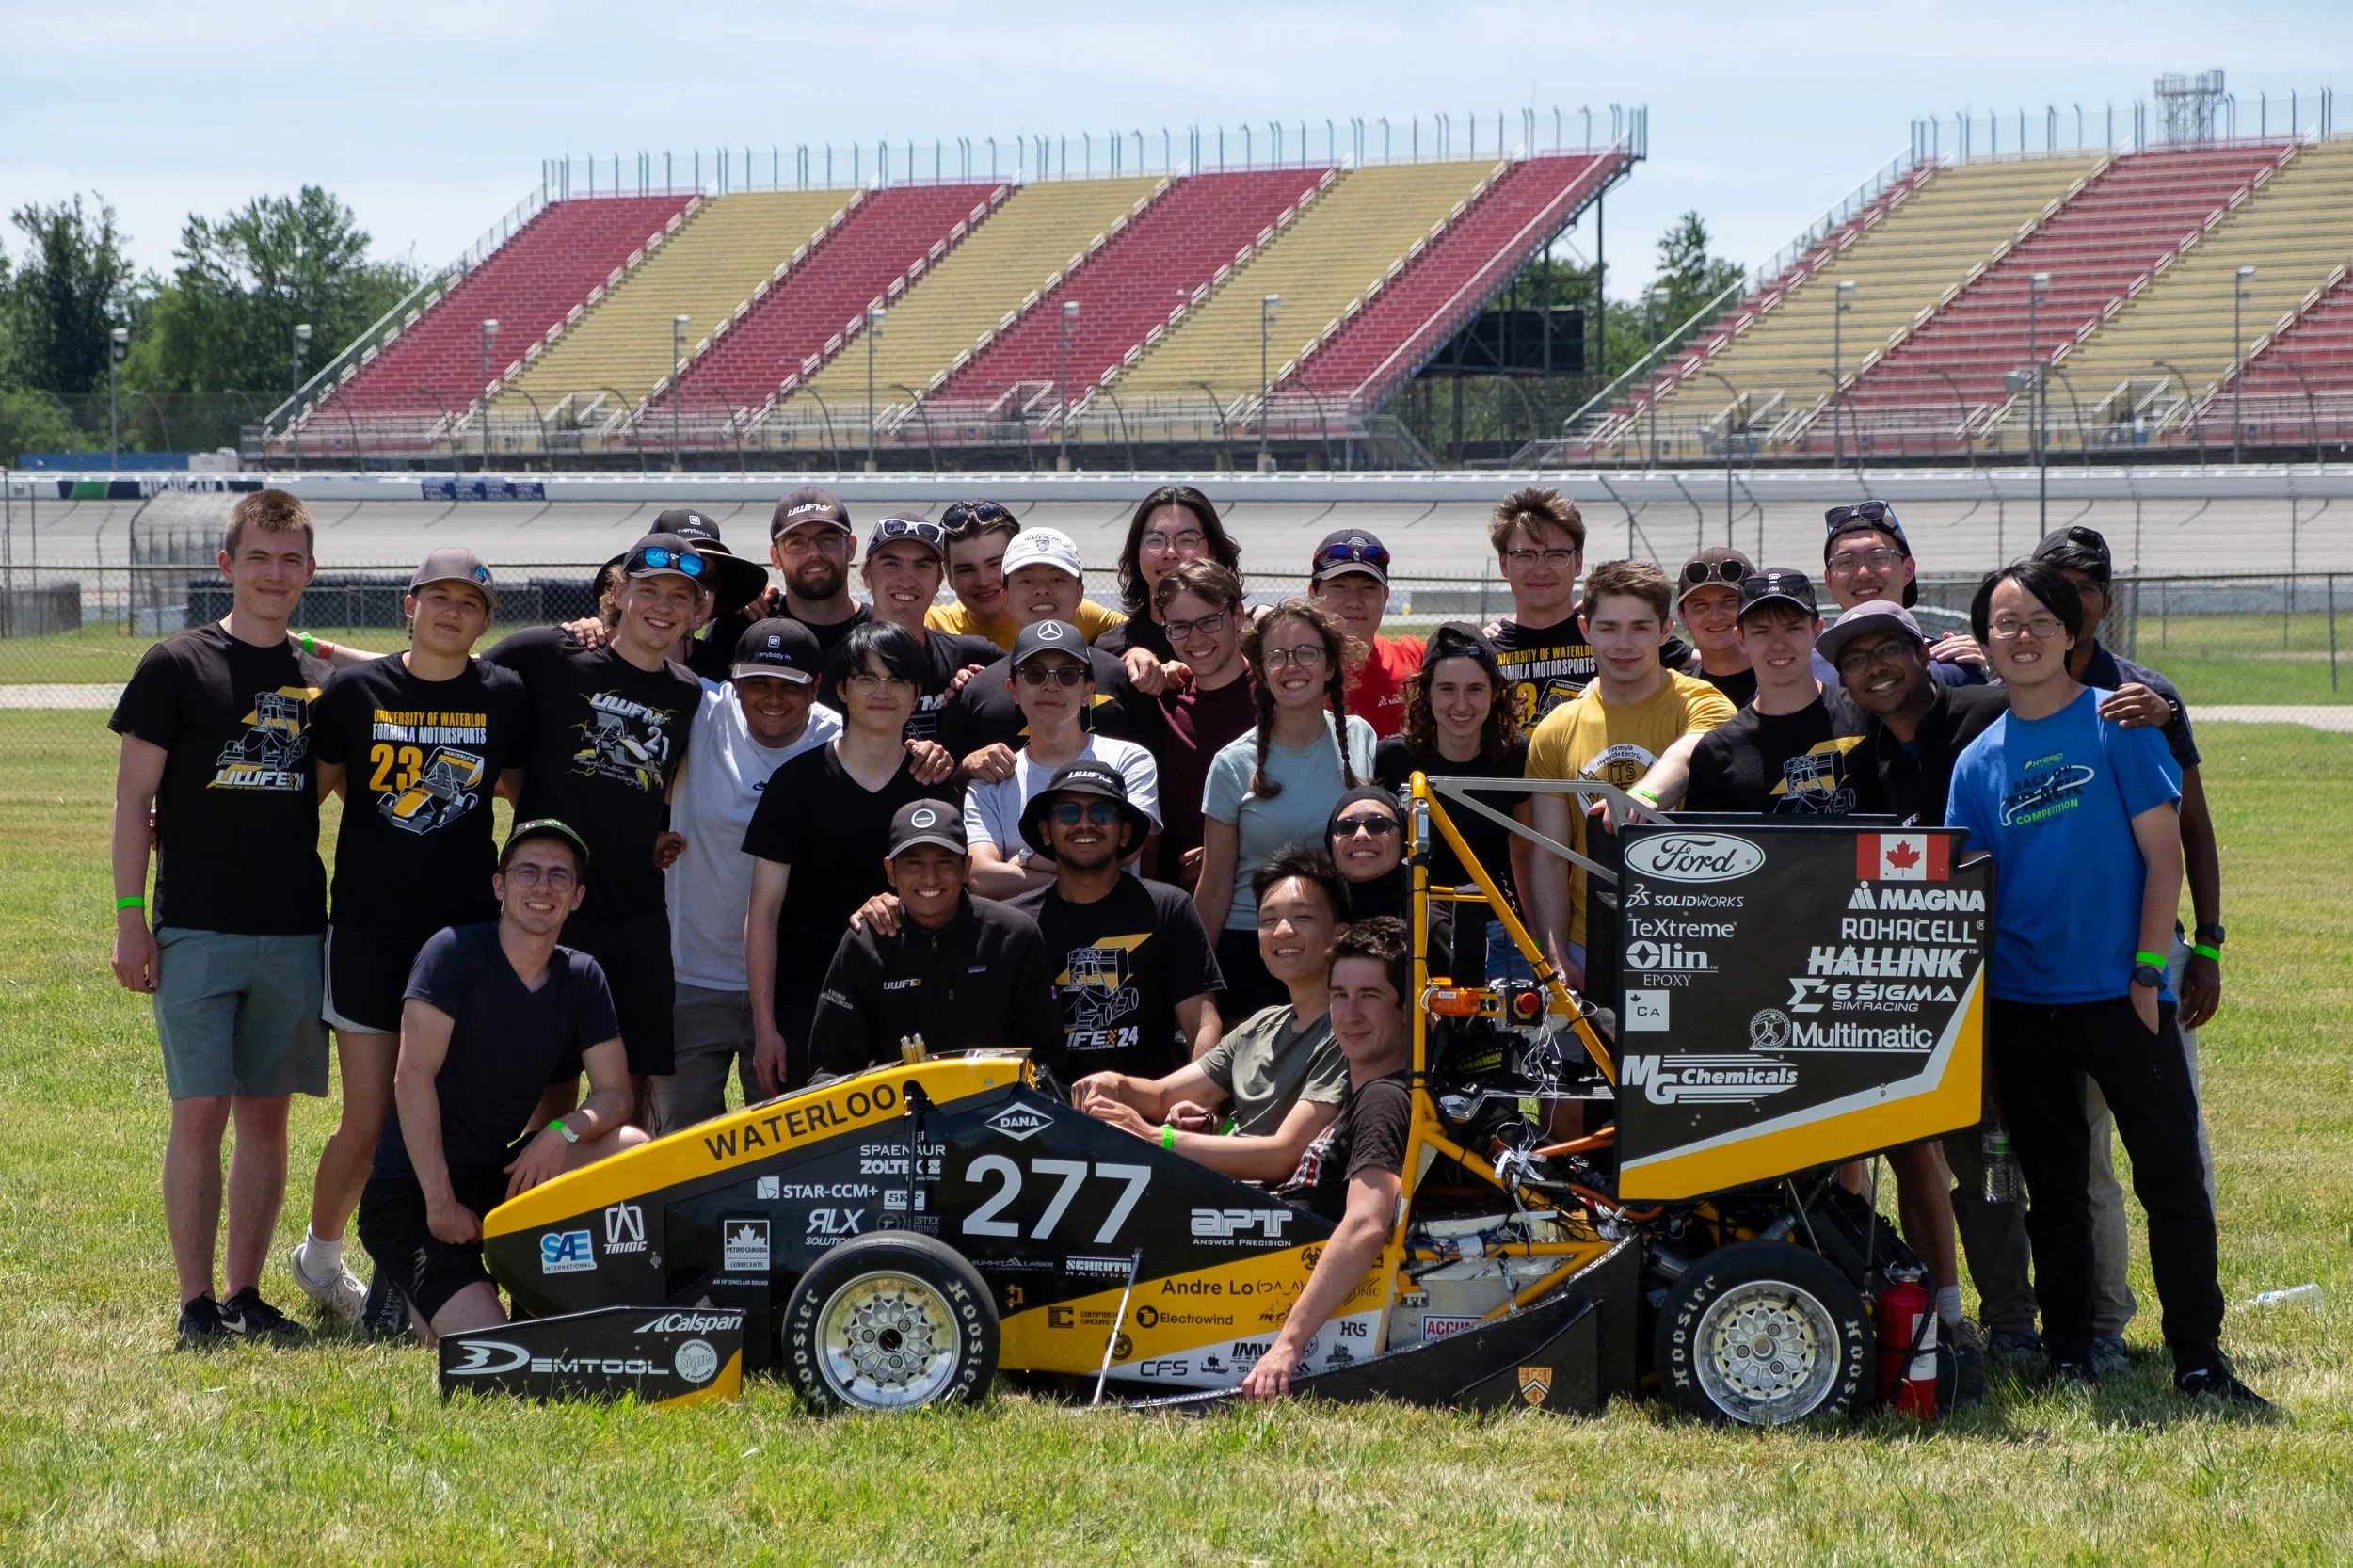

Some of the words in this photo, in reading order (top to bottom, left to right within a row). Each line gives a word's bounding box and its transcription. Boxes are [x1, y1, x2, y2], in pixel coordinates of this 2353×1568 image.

[1497, 648, 1537, 665] NIVERSITY
[1540, 648, 1549, 661] OF
[1533, 657, 1595, 678] MOTORSPORTS
[374, 709, 425, 726] UNIVERSITY
[426, 712, 439, 726] OF
[440, 712, 487, 727] WATERLOO
[373, 723, 416, 743] FORMULA
[418, 726, 487, 744] MOTORSPORTS
[443, 749, 476, 763] WATERLOO
[369, 744, 423, 792] 23
[2016, 798, 2079, 825] COMPETITION
[1651, 838, 1737, 873] Ford
[1654, 894, 1744, 908] SOLIDWORKS
[1879, 888, 1986, 912] MAGNA
[1627, 918, 1735, 938] TeXtreme
[1643, 973, 1691, 987] EPOXY
[1832, 984, 1852, 1001] 6
[1855, 984, 1958, 1002] SIGMA
[1832, 1000, 1861, 1012] SIM
[1862, 1001, 1919, 1013] RACING
[1117, 1025, 1139, 1047] 24
[1791, 1021, 1933, 1048] Multimatic
[1622, 1055, 1677, 1105] MG
[1681, 1068, 1799, 1085] Chemicals
[703, 1083, 897, 1161] WATERLOO
[1000, 1116, 1039, 1128] DANA
[783, 1184, 879, 1199] STAR-CCM+
[962, 1154, 1152, 1244] 277
[542, 1234, 591, 1263] SAE
[603, 1240, 648, 1254] TMMC
[544, 1262, 592, 1272] INTERNATIONAL
[1065, 1259, 1132, 1272] SCHROTH
[1161, 1279, 1222, 1296] Andre
[1229, 1280, 1254, 1296] Lo
[1352, 1288, 1381, 1297] ONIC
[664, 1313, 743, 1336] Calspan
[1160, 1312, 1234, 1326] Electrowind
[1340, 1321, 1368, 1337] HRS
[1672, 1274, 1717, 1390] Hoosier
[679, 1352, 715, 1374] Signs
[1140, 1360, 1189, 1377] CFS
[1829, 1319, 1864, 1412] Hoosi
